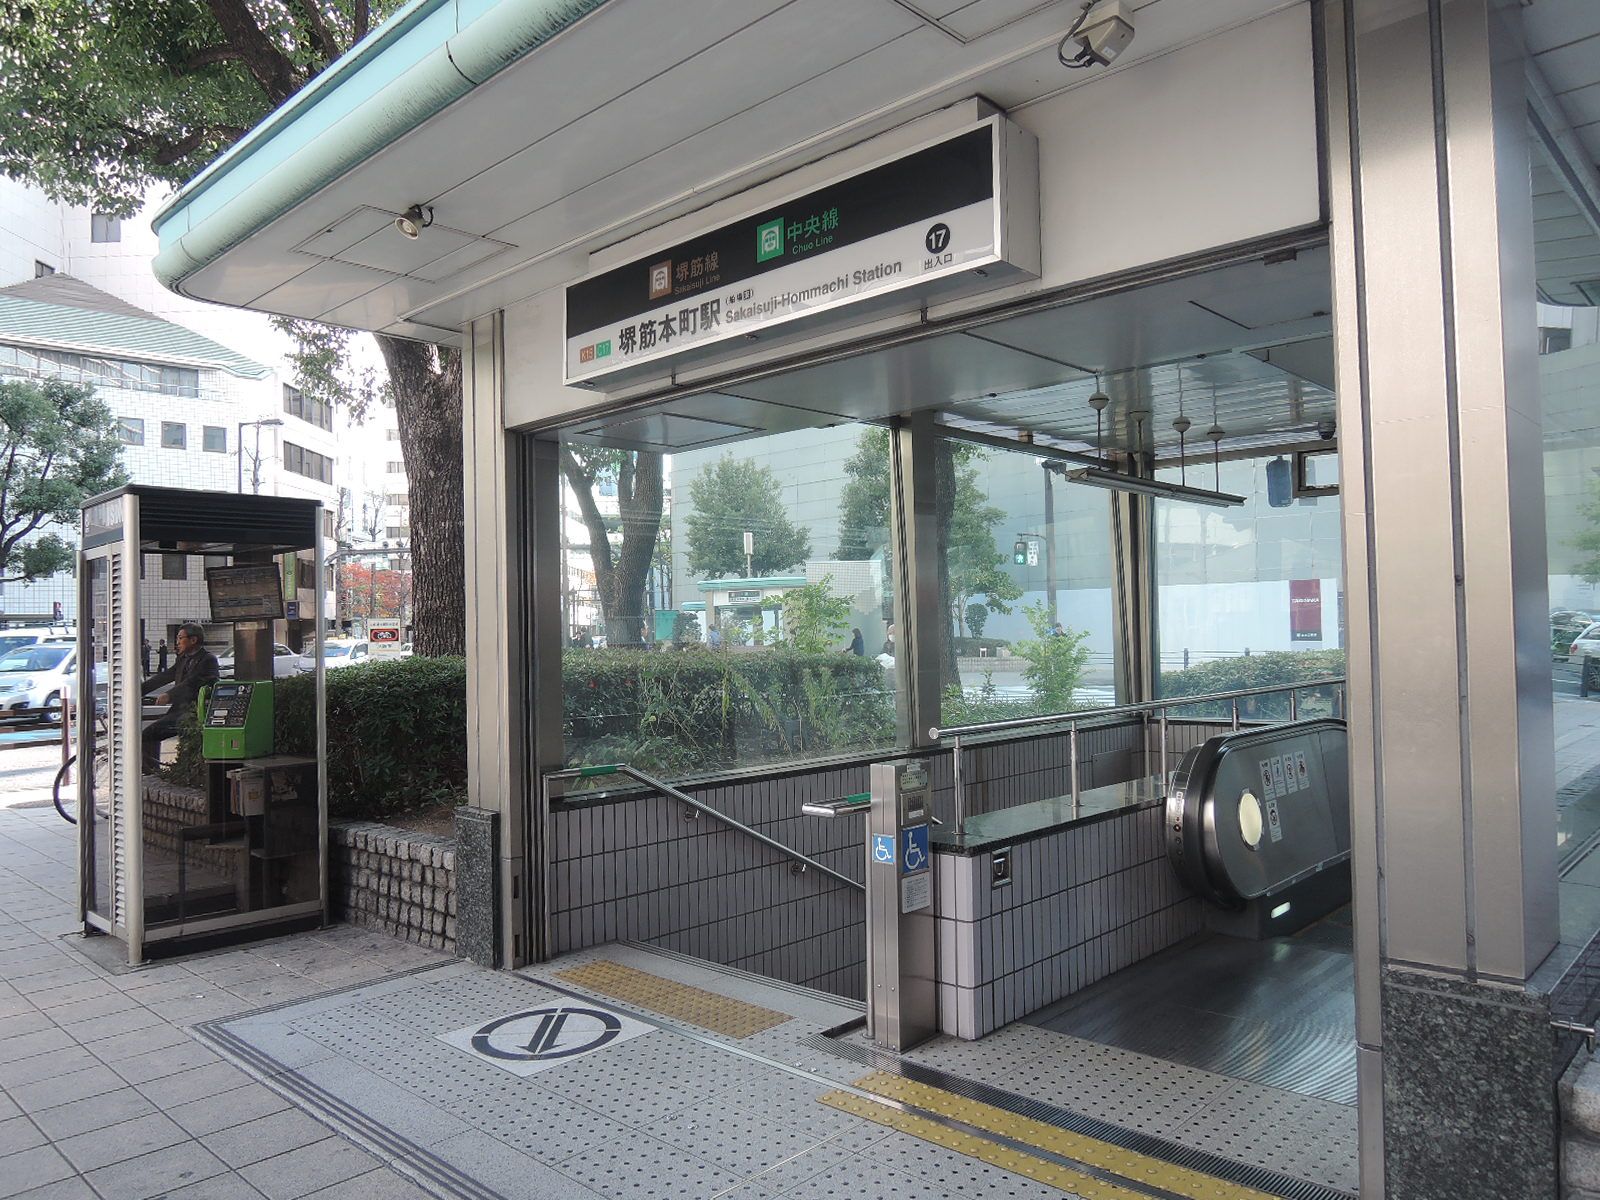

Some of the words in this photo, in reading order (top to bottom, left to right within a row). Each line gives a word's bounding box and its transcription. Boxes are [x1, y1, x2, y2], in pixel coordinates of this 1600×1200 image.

[787, 207, 839, 242] 中央線
[792, 240, 814, 255] Chuo
[816, 234, 833, 247] Line
[929, 228, 947, 250] 17
[675, 251, 720, 282] 堺筋線
[924, 253, 953, 270] 出入口
[674, 277, 704, 295] Sakaisuji
[706, 273, 721, 285] Line
[725, 274, 849, 324] Sakaisuji-Hommachi
[853, 259, 903, 286] Station
[618, 298, 721, 356] 堺筋本町駅
